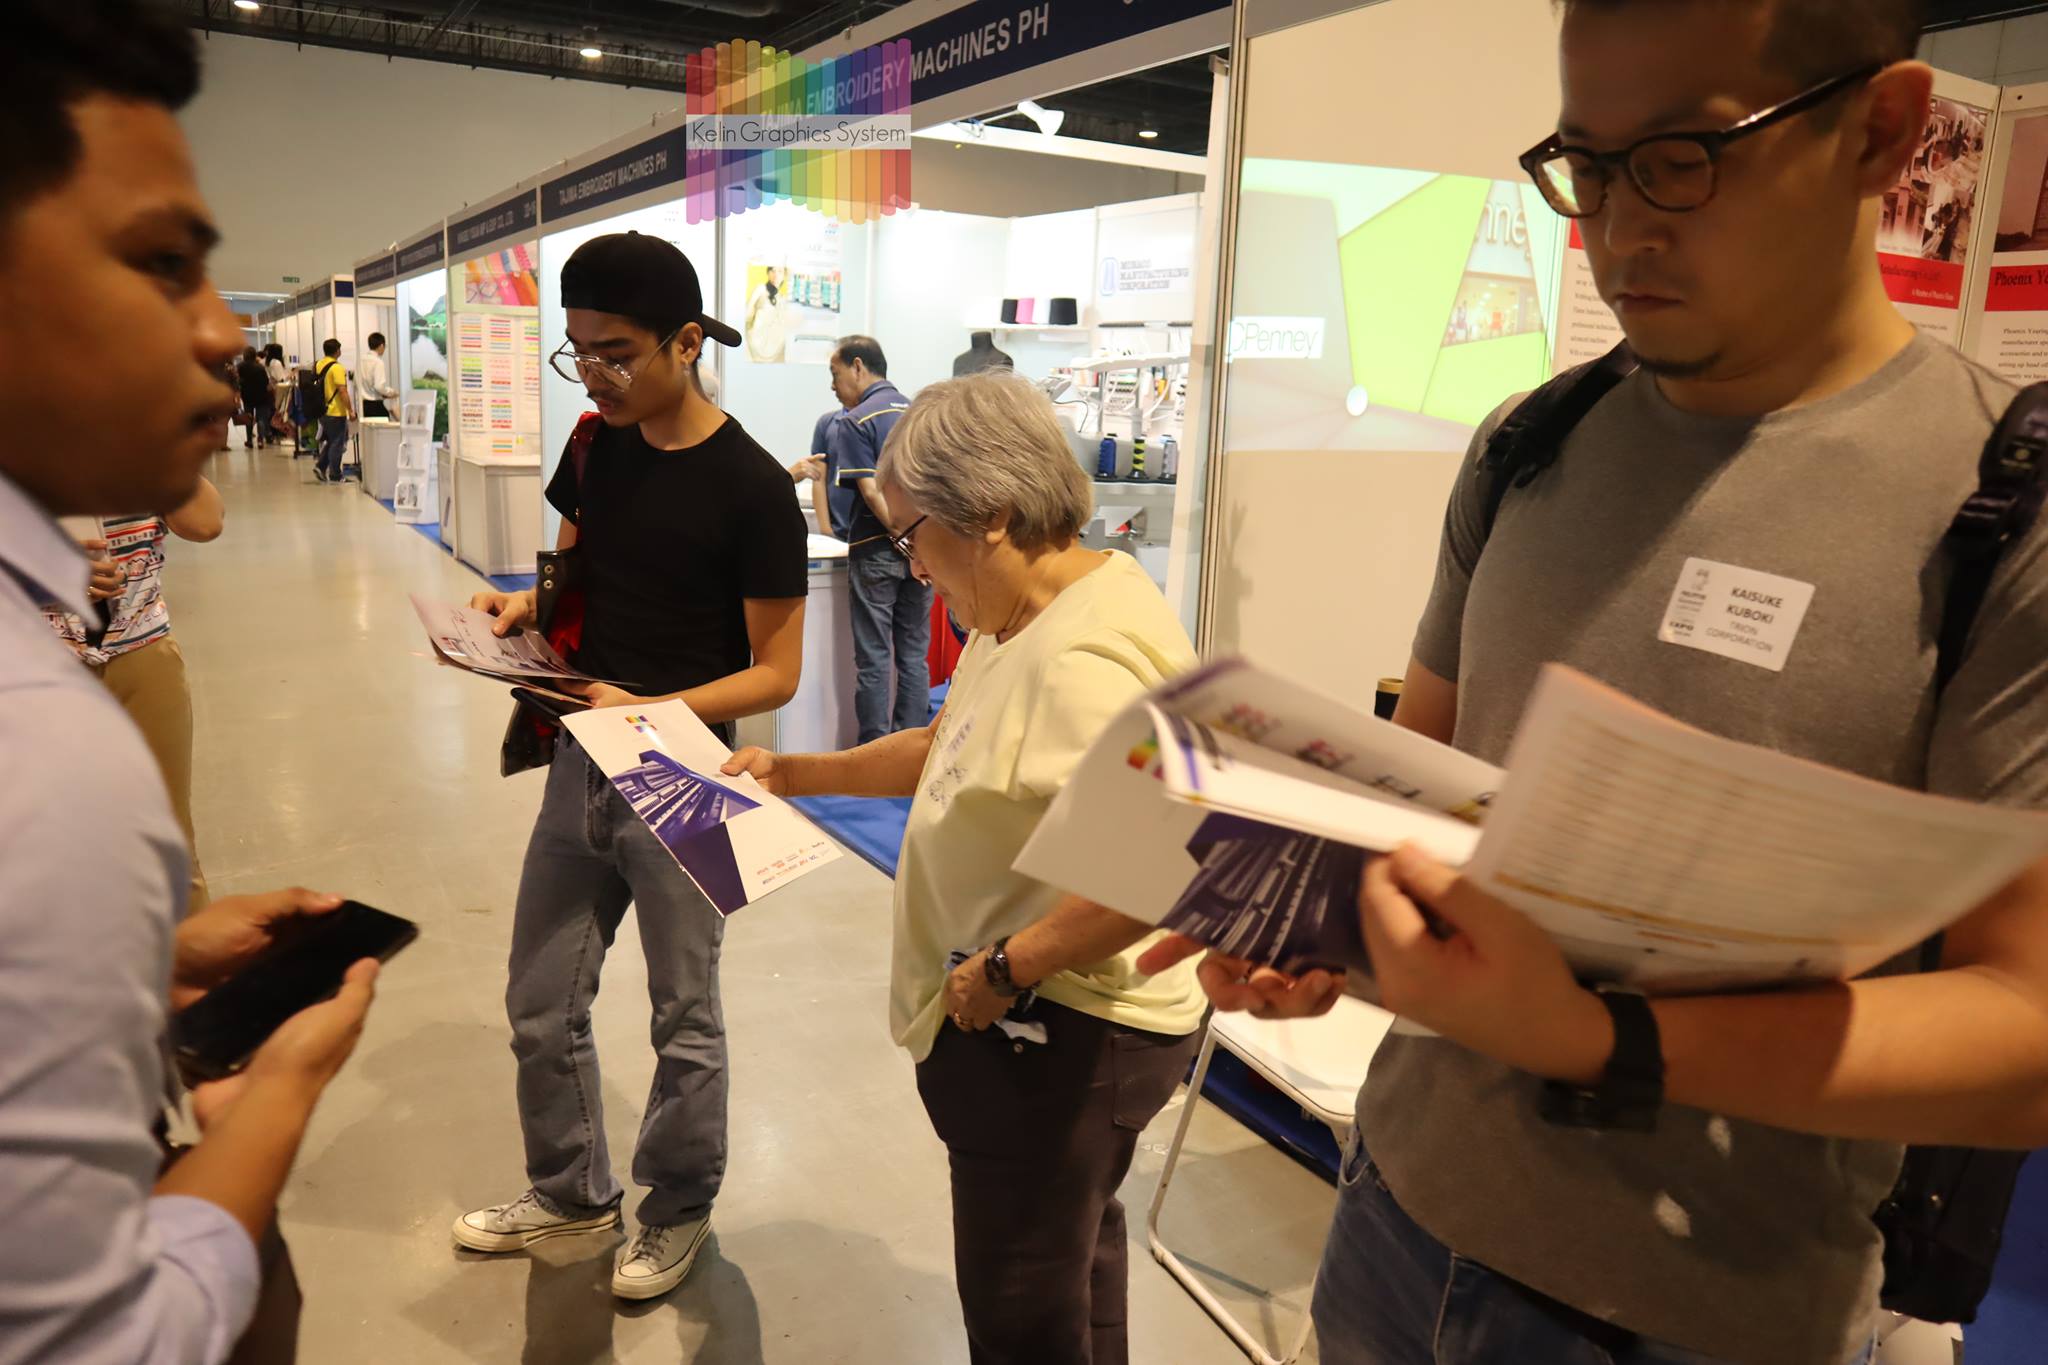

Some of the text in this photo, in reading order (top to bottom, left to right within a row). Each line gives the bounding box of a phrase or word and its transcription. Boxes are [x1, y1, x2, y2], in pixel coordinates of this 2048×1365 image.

[806, 57, 905, 118] EMBROIDERY
[910, 17, 1011, 81] MACHINES
[1017, 2, 1049, 44] PH
[578, 169, 617, 199] EMBROIDERY
[617, 155, 655, 186] MACHINES
[655, 150, 668, 173] PH
[1994, 271, 2033, 288] Phoenix
[1730, 586, 1784, 609] KAISUKE
[1726, 604, 1775, 625] KUBOKI
[1705, 627, 1774, 652] CORPORATION
[1729, 621, 1759, 636] TRION
